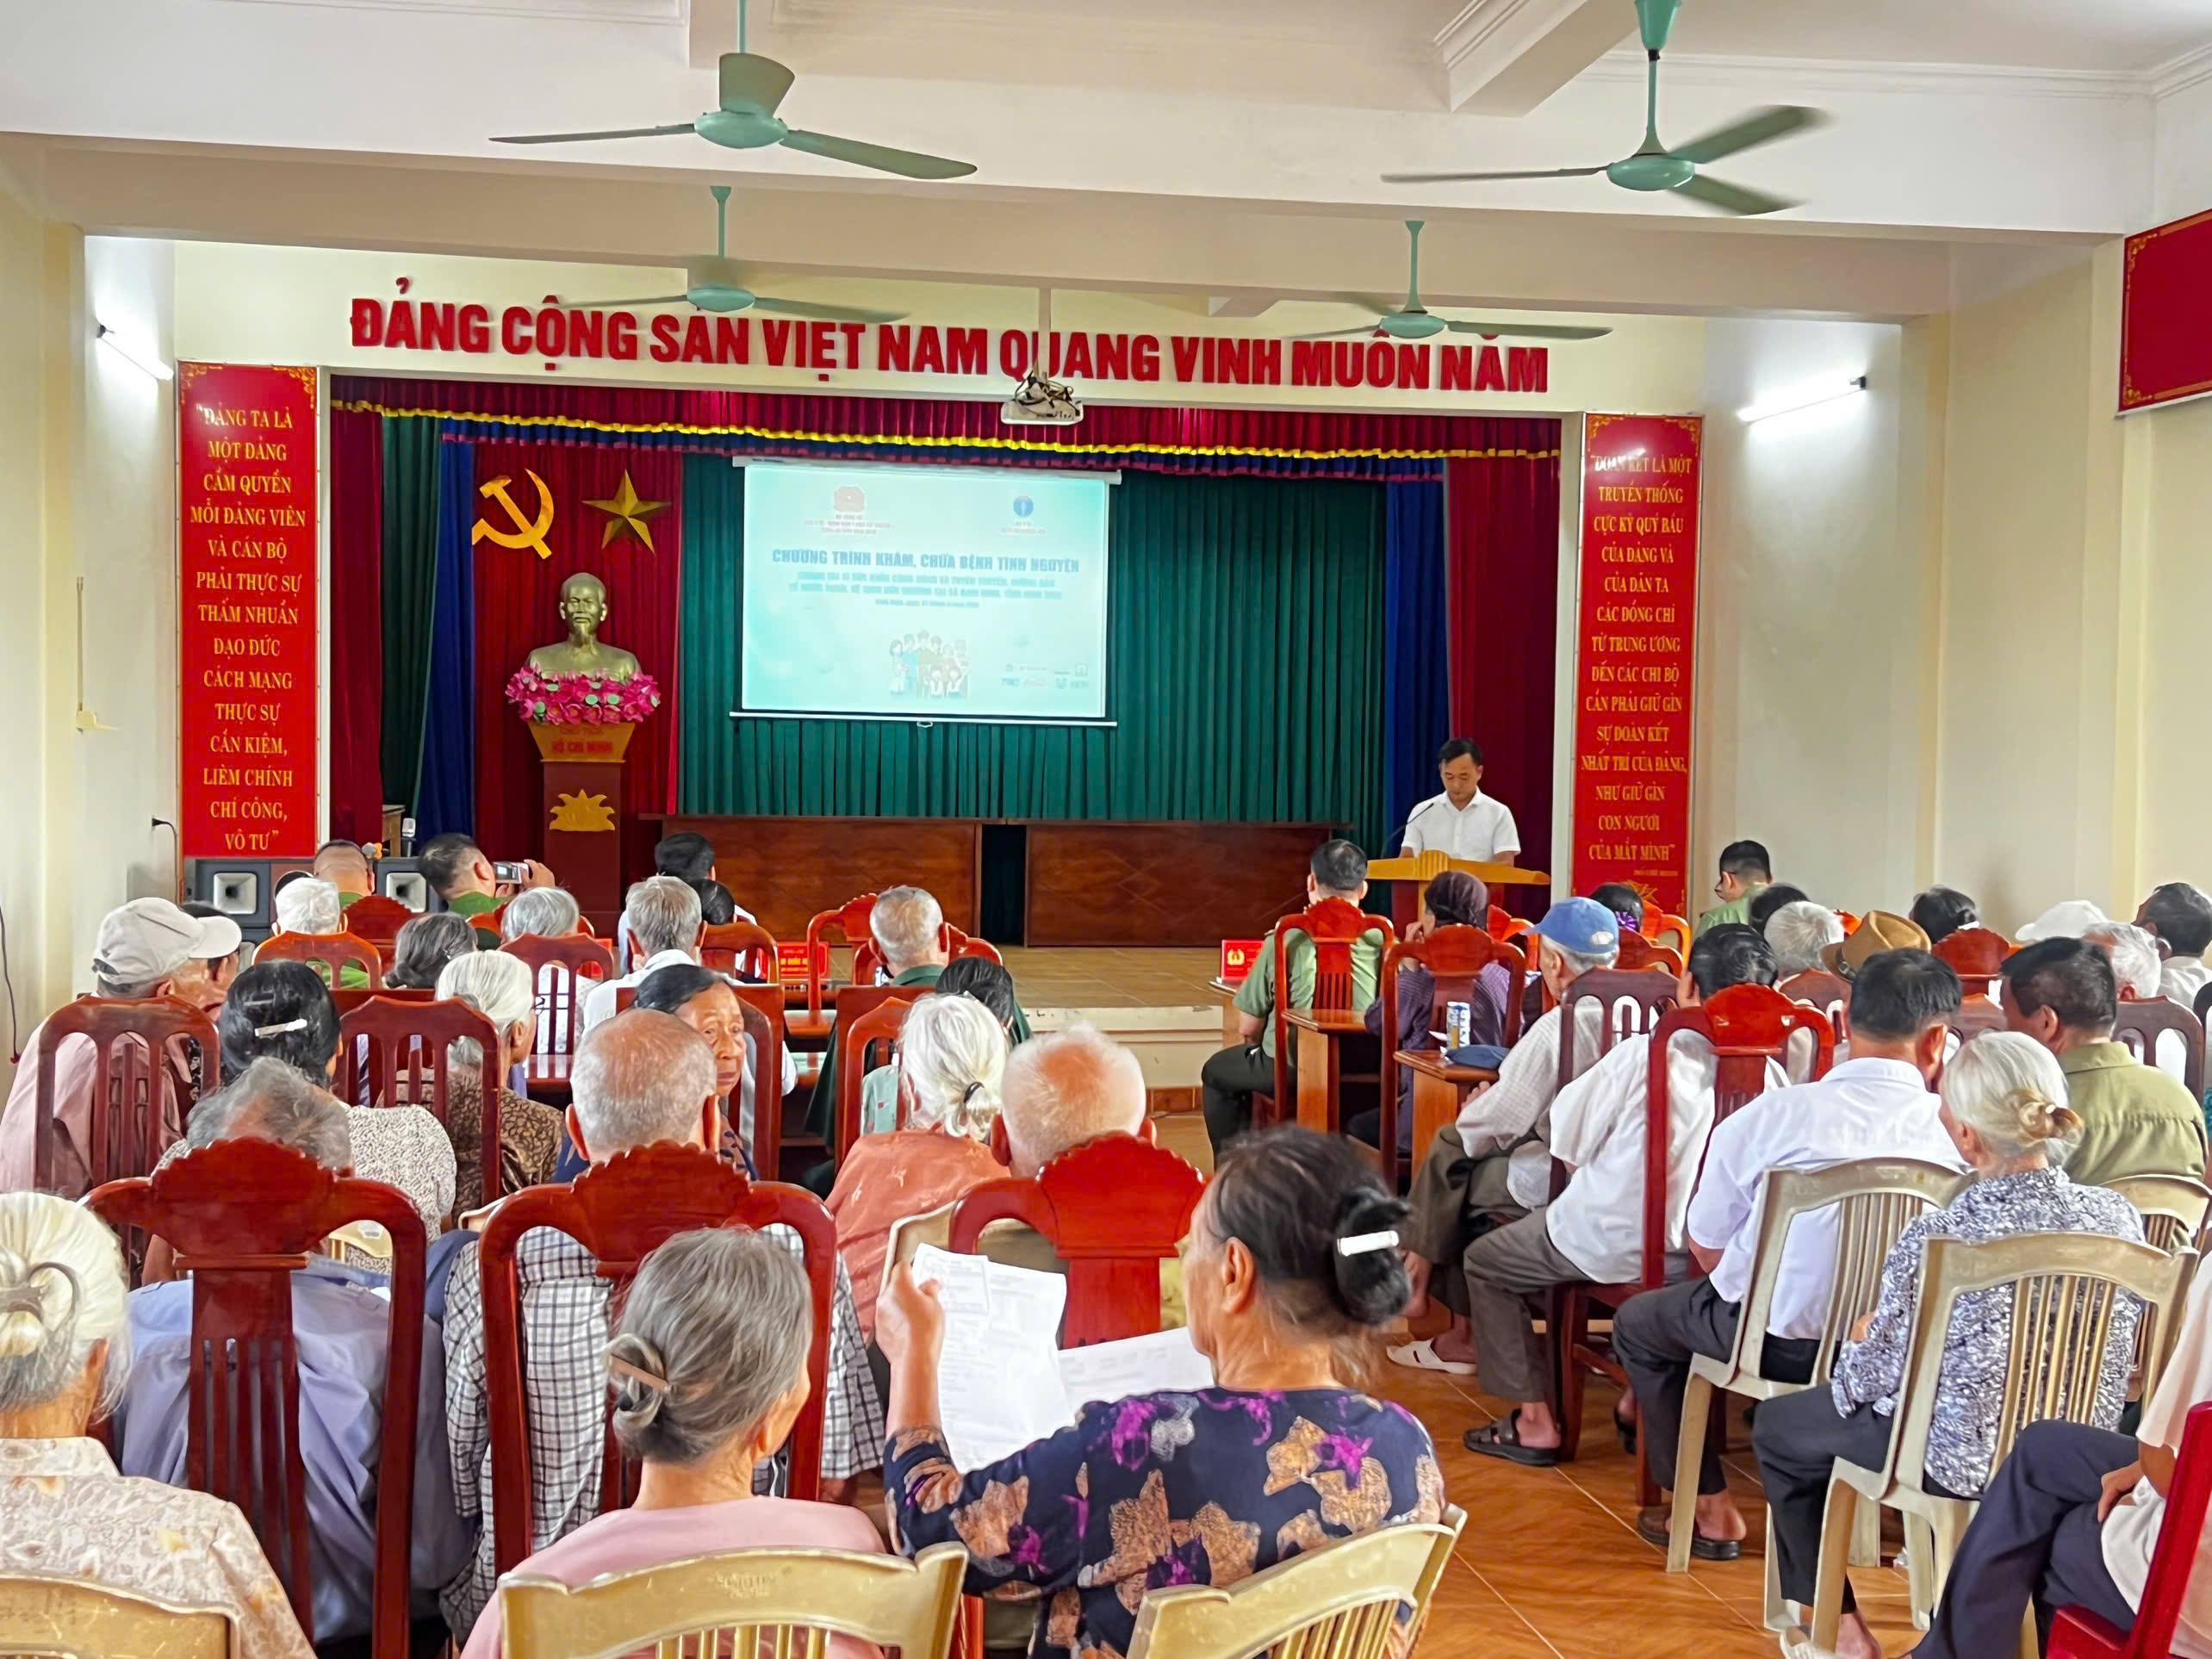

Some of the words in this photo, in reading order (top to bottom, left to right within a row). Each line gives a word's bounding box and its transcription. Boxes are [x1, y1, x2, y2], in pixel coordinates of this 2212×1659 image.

[350, 277, 490, 354] ĐẢNG
[501, 295, 638, 370] CỘNG
[877, 324, 987, 376] NAM
[1000, 329, 1159, 382] QUANG
[1171, 337, 1281, 386] VINH
[250, 410, 270, 428] TA
[274, 406, 293, 429] LÀ
[208, 437, 241, 463] MỘT
[270, 505, 307, 527] VIÊN
[208, 534, 227, 557] VÀ
[232, 535, 263, 559] CÁN
[266, 537, 288, 564] BỘ
[196, 566, 232, 590] PHẢI
[236, 572, 278, 596] THỰC
[282, 572, 302, 597] SỰ
[1656, 577, 1669, 593] TA
[249, 634, 281, 657] ĐỨC
[1609, 636, 1647, 653] TRUNG
[203, 664, 244, 687] CÁCH
[248, 670, 293, 693] MẠNG
[215, 702, 257, 724] THỰC
[259, 702, 281, 726] SỰ
[245, 731, 289, 759] KIỆM,
[245, 765, 293, 787] CHÍNH
[210, 797, 237, 817] CHÍ
[224, 829, 246, 850] VÔ
